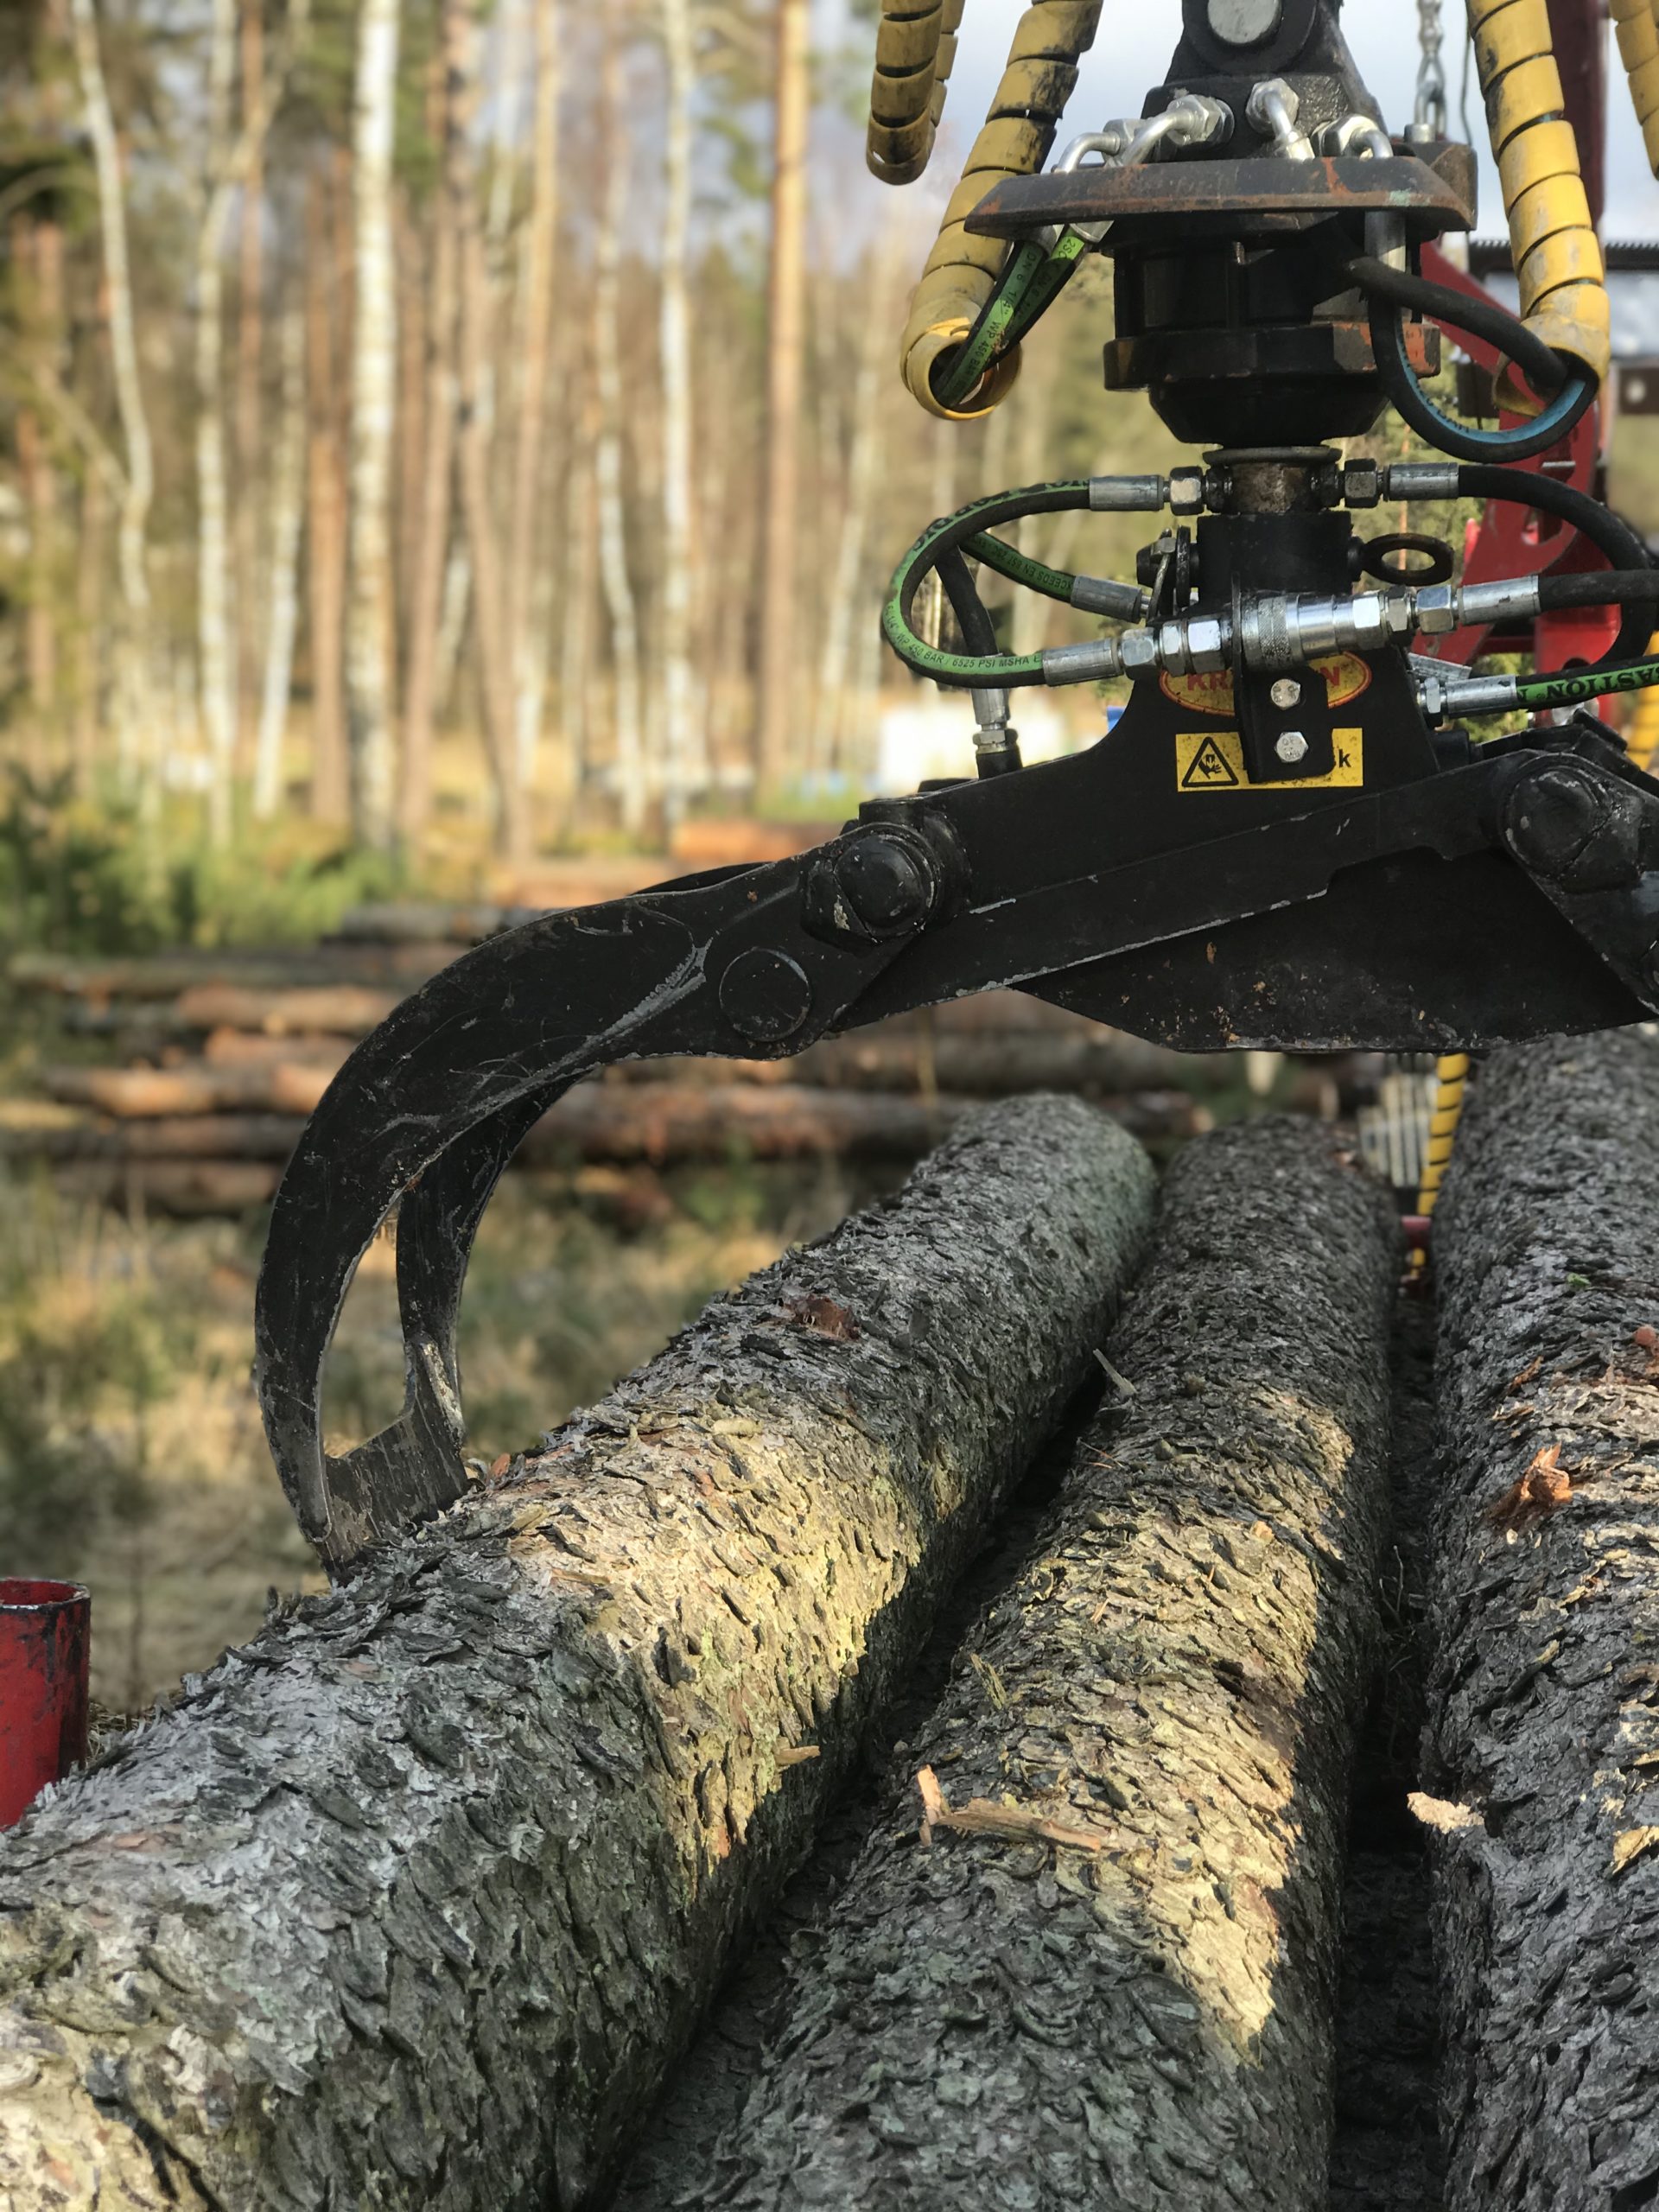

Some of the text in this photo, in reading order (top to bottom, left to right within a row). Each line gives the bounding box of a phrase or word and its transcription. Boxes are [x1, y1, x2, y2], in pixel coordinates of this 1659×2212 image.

[1023, 251, 1036, 270] DN
[1016, 273, 1025, 283] 6
[988, 321, 1002, 340] WP
[1024, 567, 1036, 578] EN
[923, 652, 944, 664] BAR
[952, 659, 976, 668] 6525
[977, 659, 995, 668] PSI
[998, 658, 1030, 668] MSHA
